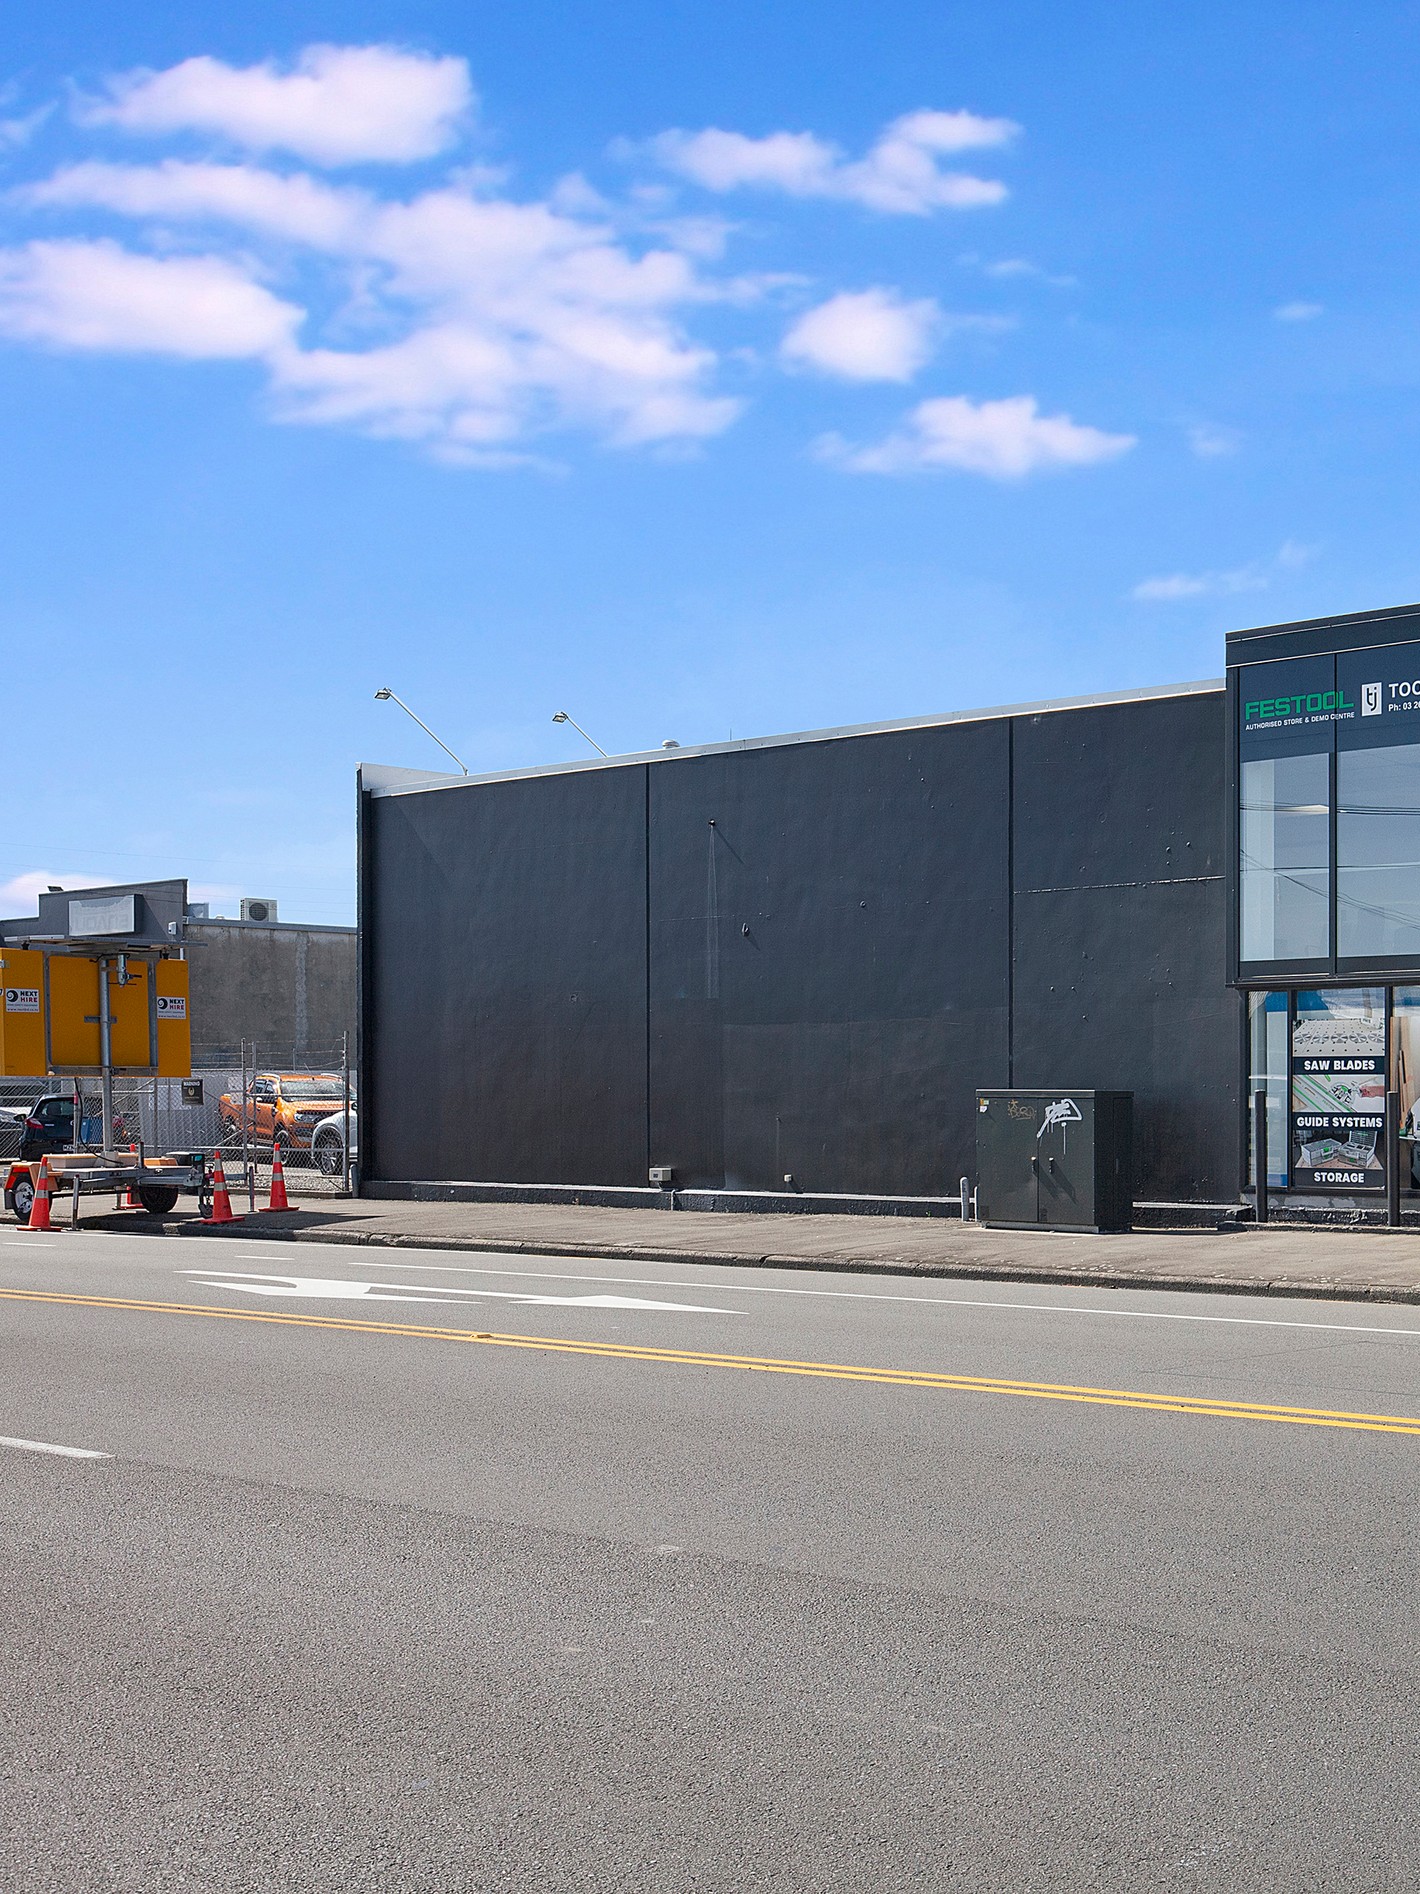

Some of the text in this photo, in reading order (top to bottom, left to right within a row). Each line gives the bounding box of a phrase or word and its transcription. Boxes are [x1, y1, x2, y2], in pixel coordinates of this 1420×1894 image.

[1246, 690, 1354, 720] FESTOOL
[1388, 704, 1401, 712] Ph:
[1402, 702, 1412, 710] 03
[1246, 720, 1282, 730] AUTHORISED
[1284, 718, 1302, 726] STORE
[1311, 714, 1329, 722] DEMO
[1330, 712, 1354, 720] CENTRE
[1304, 1060, 1376, 1070] SAW BLADES
[1296, 1117, 1383, 1128] GUIDE SYSTEMS
[1314, 1172, 1365, 1183] STORAGE
